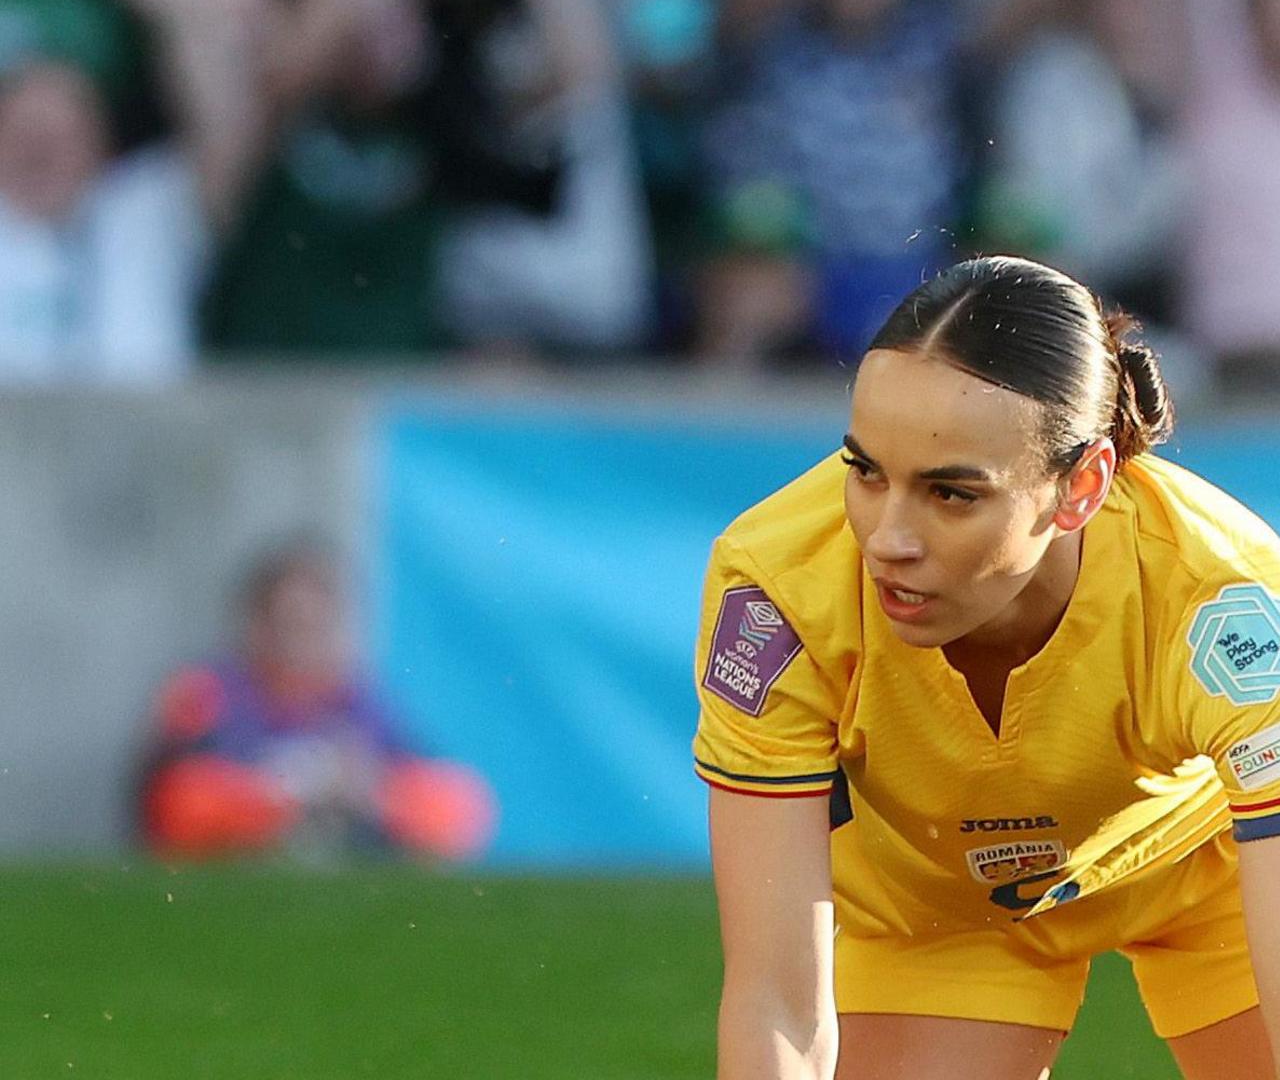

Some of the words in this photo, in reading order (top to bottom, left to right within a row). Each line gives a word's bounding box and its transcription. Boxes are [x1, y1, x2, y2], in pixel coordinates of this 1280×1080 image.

[1217, 632, 1240, 647] We
[1234, 639, 1279, 671] Strong
[713, 666, 756, 700] LEAGUE
[714, 652, 762, 690] NATIONS
[975, 844, 1053, 862] ROMÂNIA
